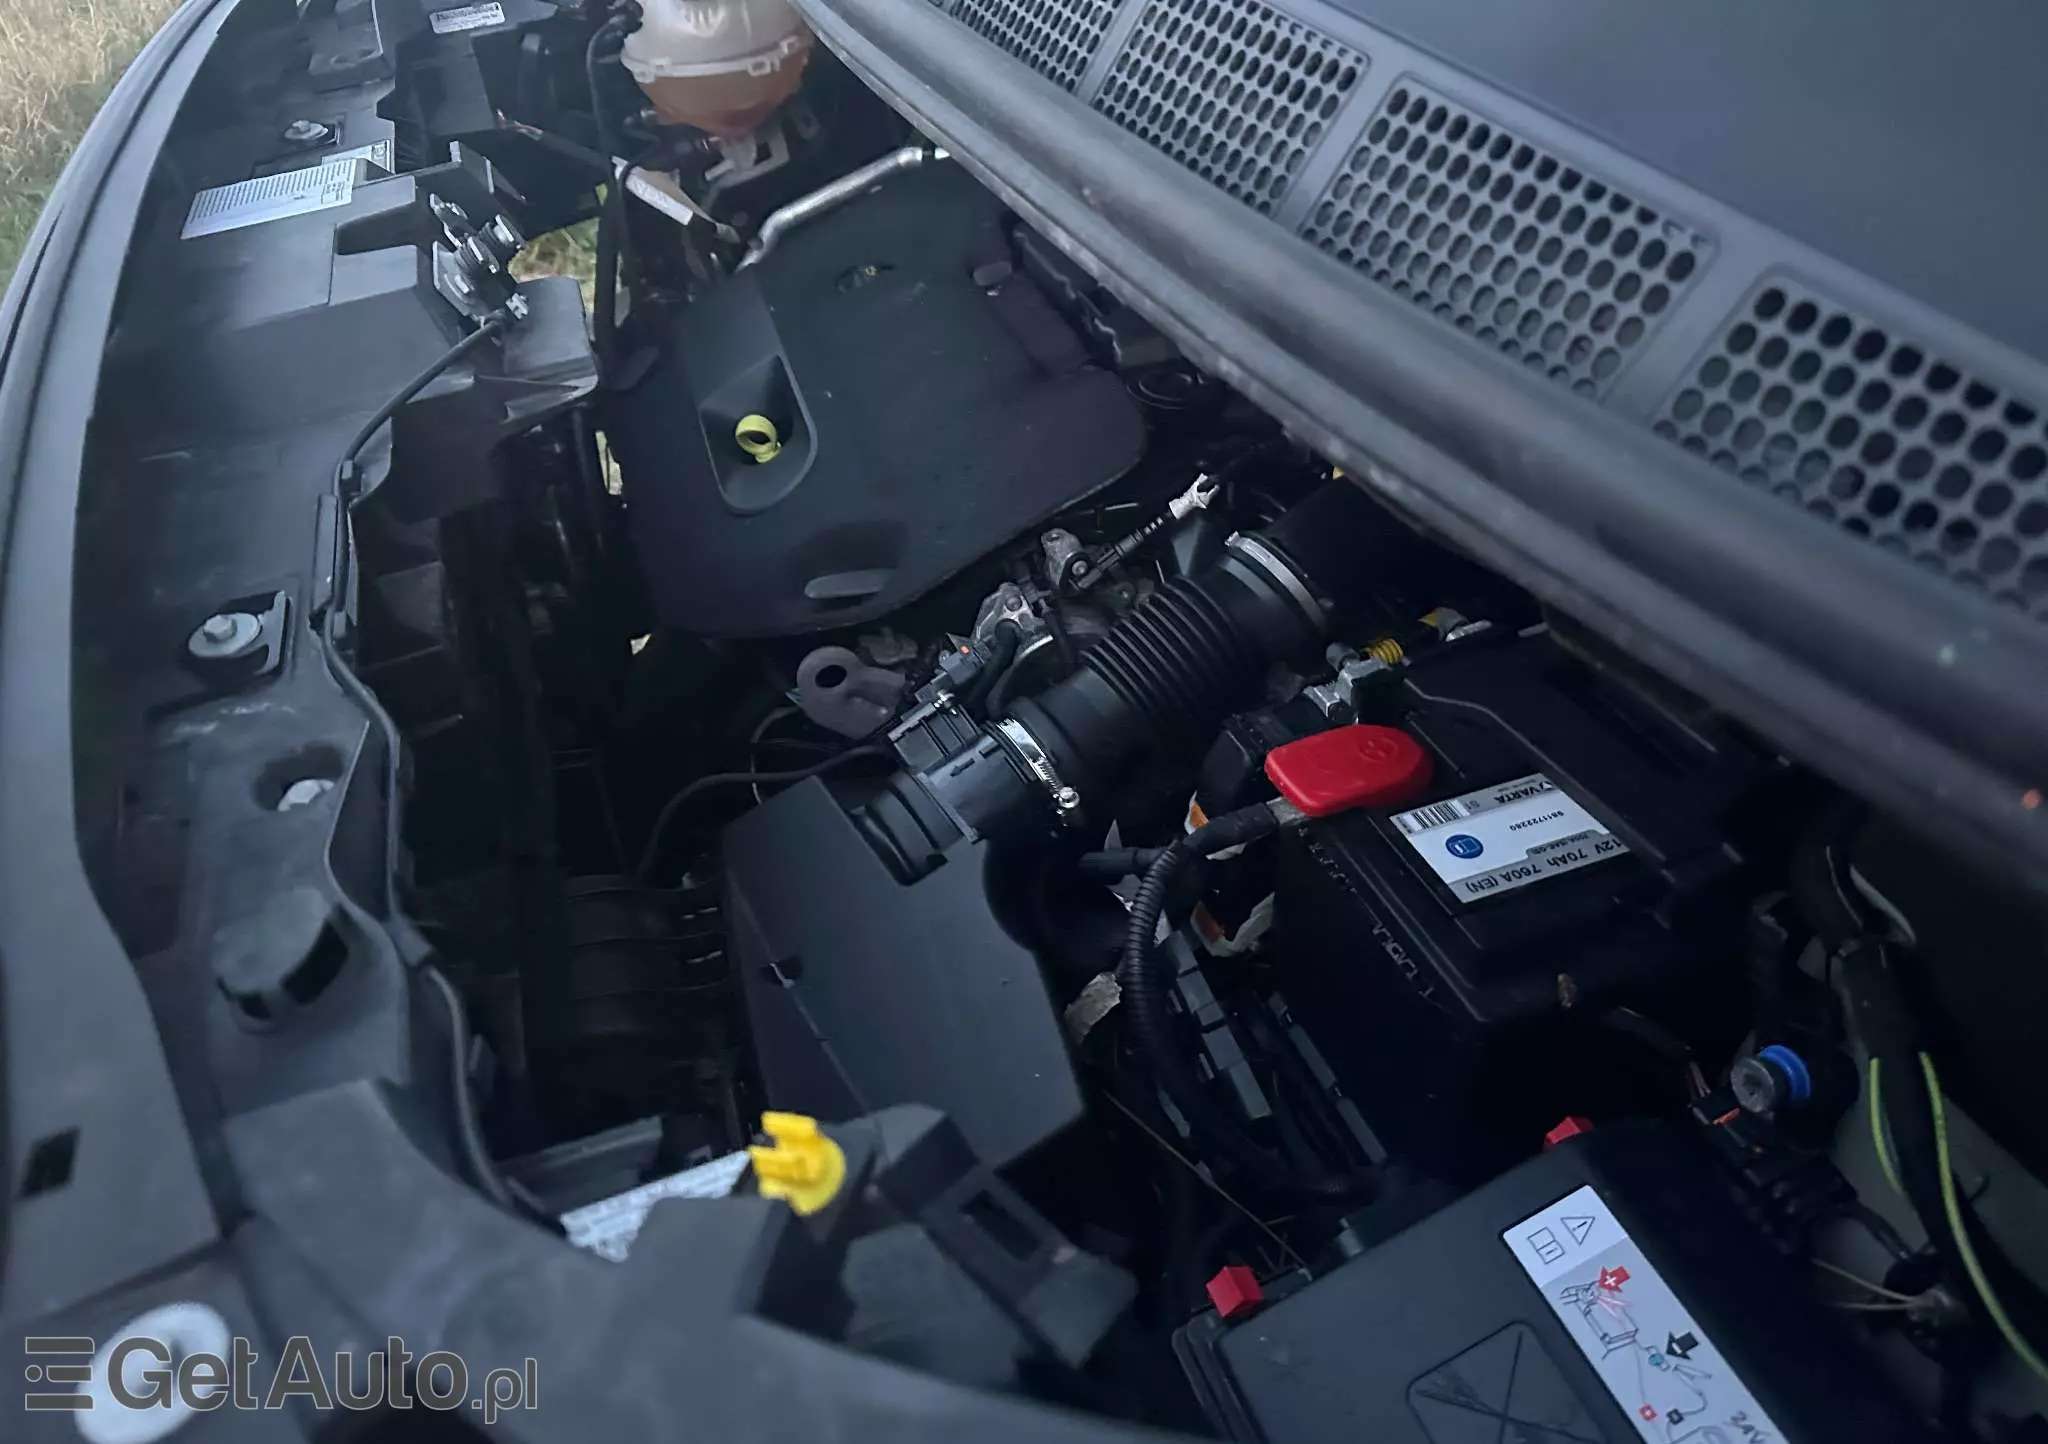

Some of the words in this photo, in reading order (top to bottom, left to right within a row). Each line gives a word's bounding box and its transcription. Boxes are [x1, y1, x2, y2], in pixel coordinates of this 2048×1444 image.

[1494, 782, 1541, 804] VARTA
[1595, 838, 1622, 856] 12V
[1546, 848, 1588, 868] 70Ah
[1500, 863, 1542, 884] 760A
[1464, 874, 1499, 894] (EN)
